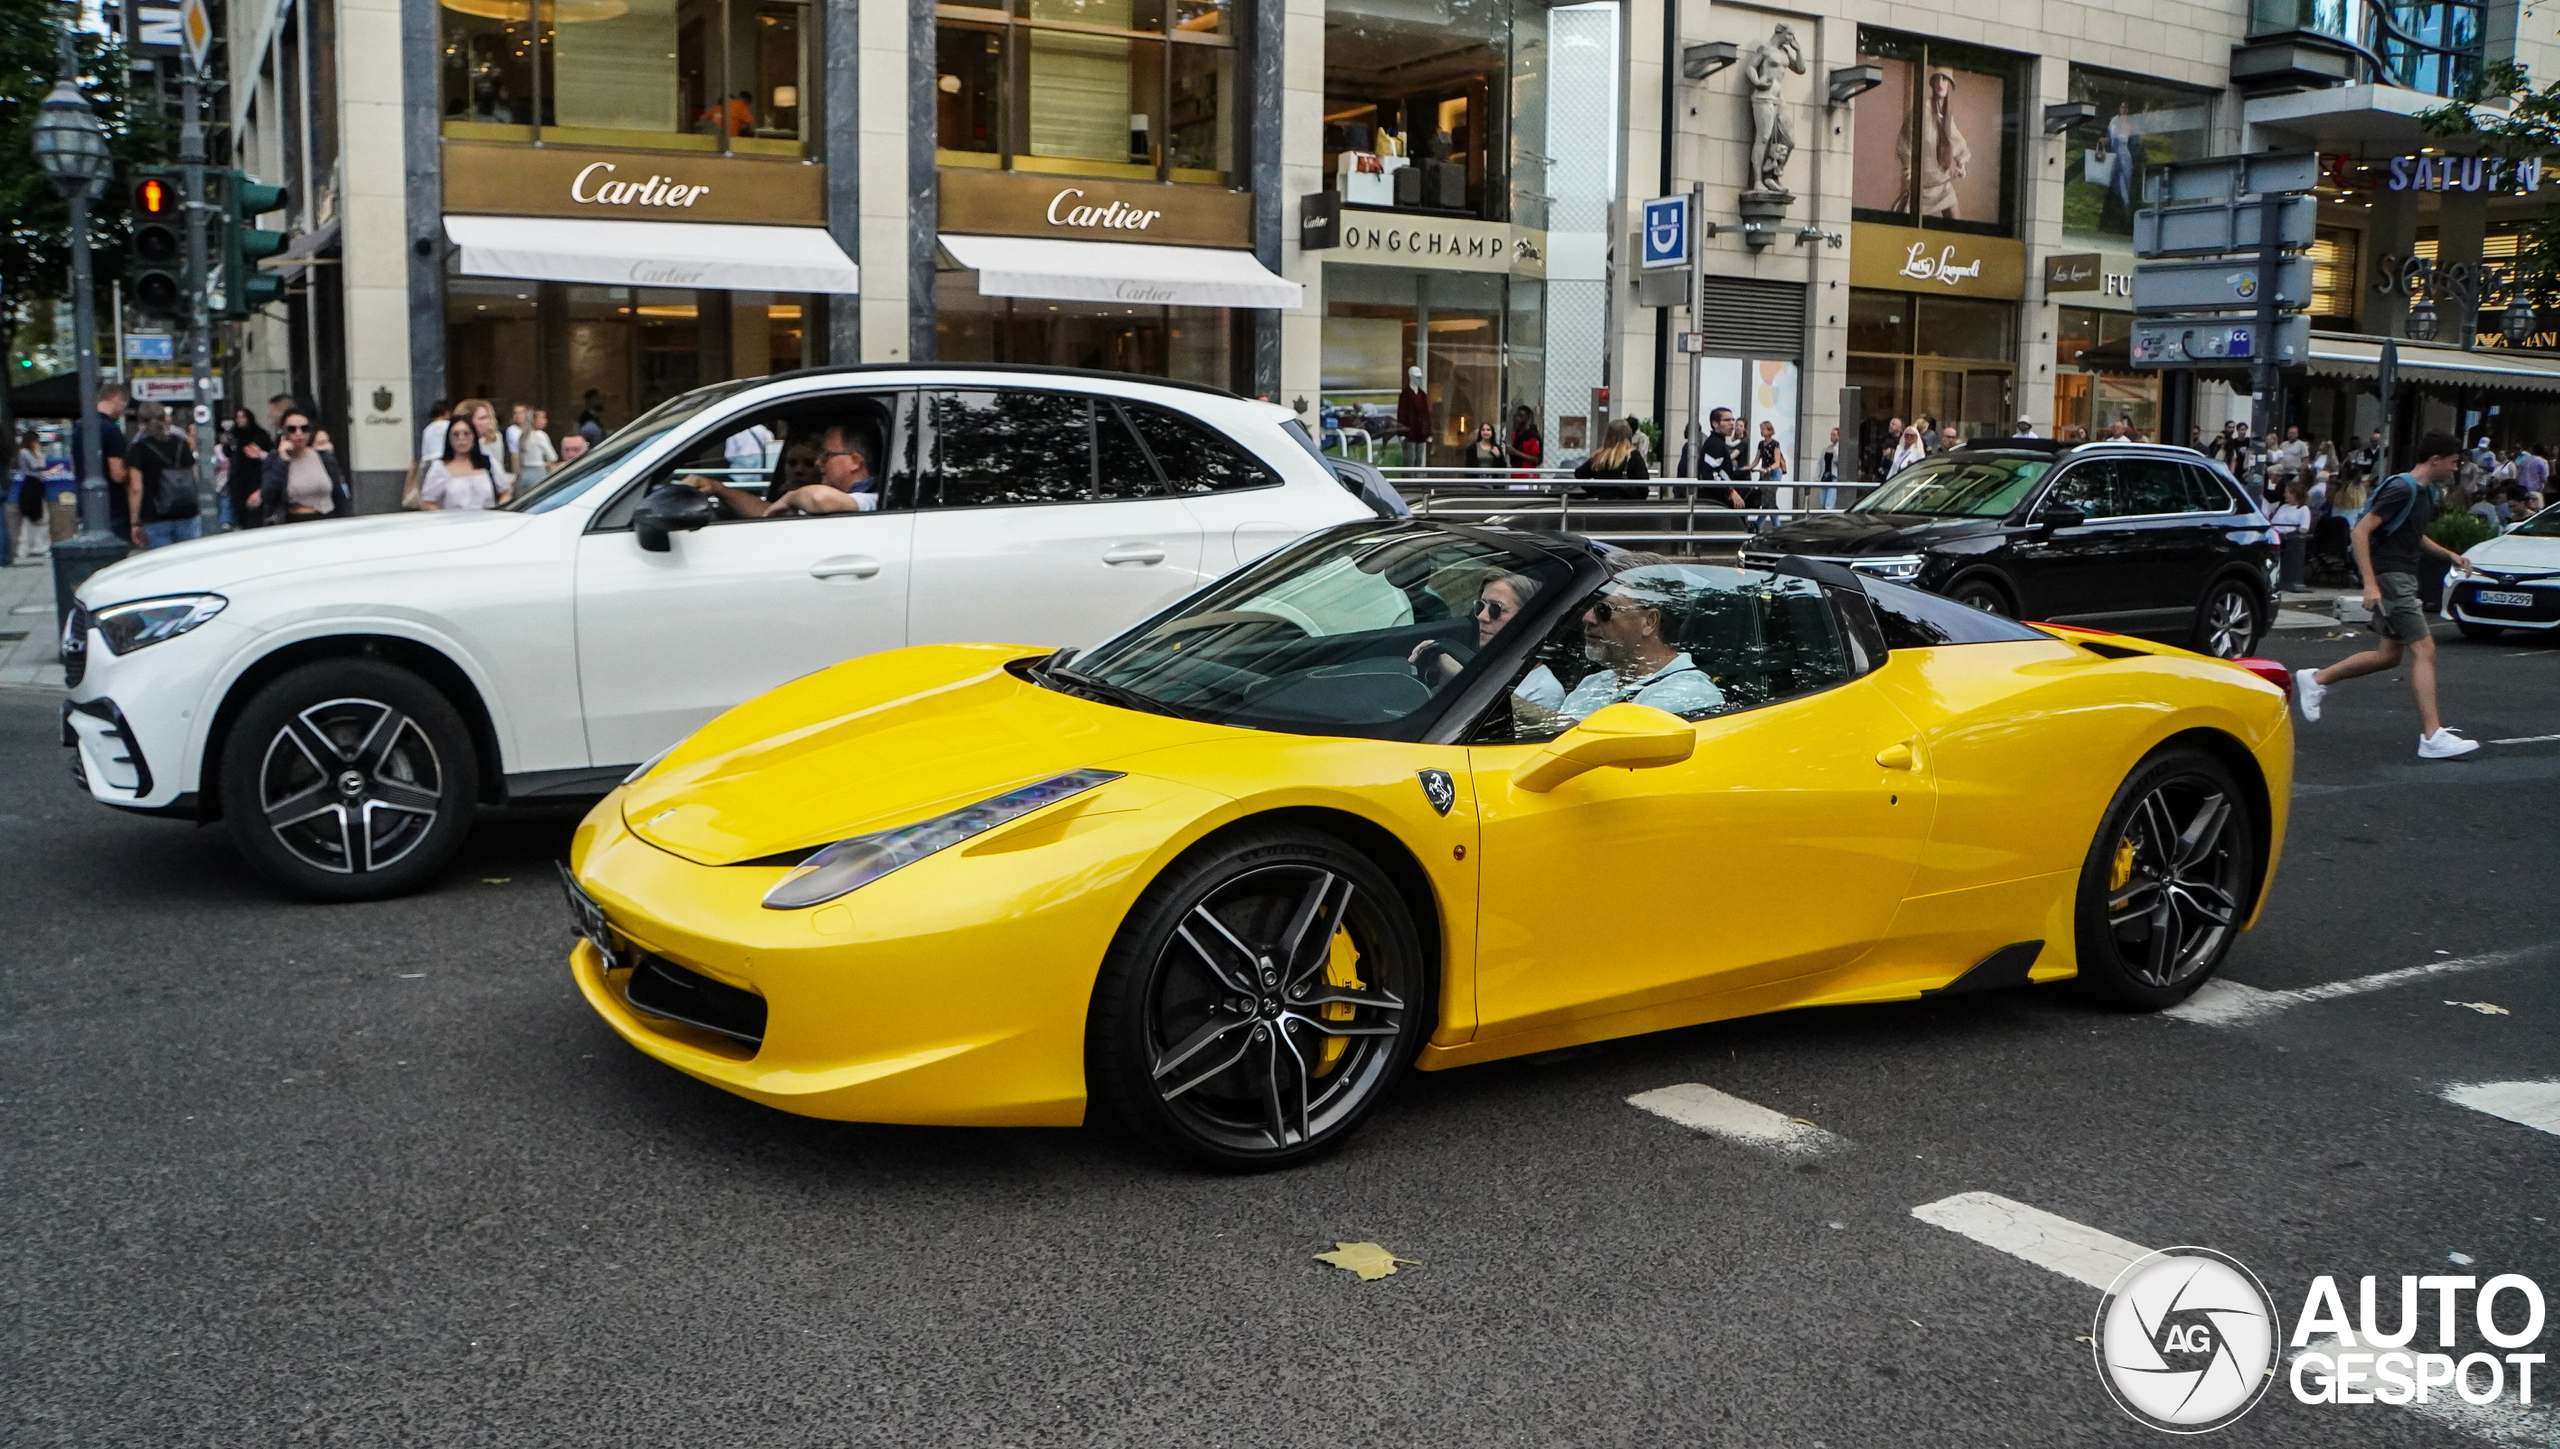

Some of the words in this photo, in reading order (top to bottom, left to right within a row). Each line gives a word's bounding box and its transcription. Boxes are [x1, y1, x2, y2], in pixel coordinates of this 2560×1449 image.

[571, 161, 710, 208] Cartier
[1046, 187, 1161, 230] Cartier
[1303, 215, 1328, 229] Cartier
[1345, 226, 1503, 258] ONGCHAMP
[629, 259, 703, 284] Cartier
[1900, 241, 1936, 279] Luisa
[1935, 245, 1981, 286] Spagnoli
[1116, 279, 1177, 301] Cartier
[2105, 273, 2134, 296] FU
